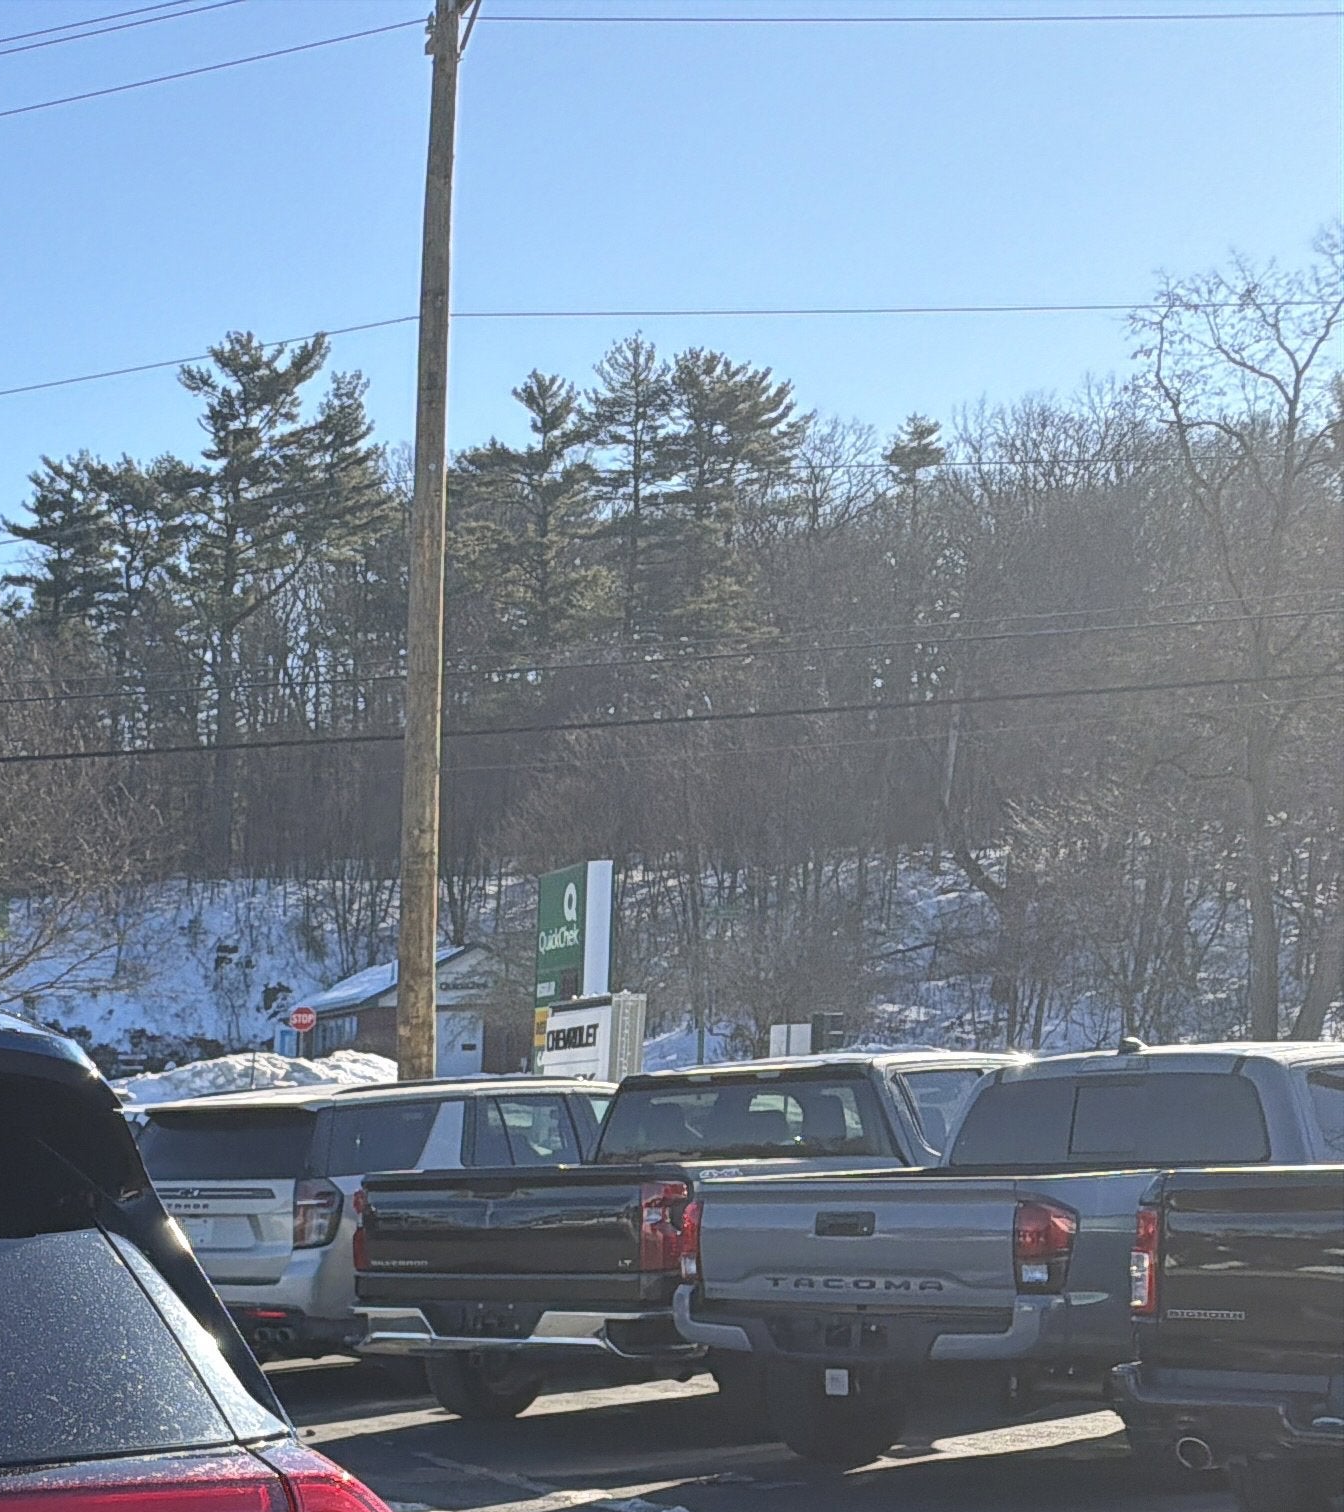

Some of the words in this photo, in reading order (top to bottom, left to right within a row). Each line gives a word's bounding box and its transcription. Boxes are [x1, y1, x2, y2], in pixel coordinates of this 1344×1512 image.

[538, 927, 579, 954] QuickChek
[292, 1013, 314, 1024] STOP
[547, 1023, 599, 1051] CHEVROLET
[618, 1259, 632, 1267] LT
[765, 1276, 943, 1291] TACOMA
